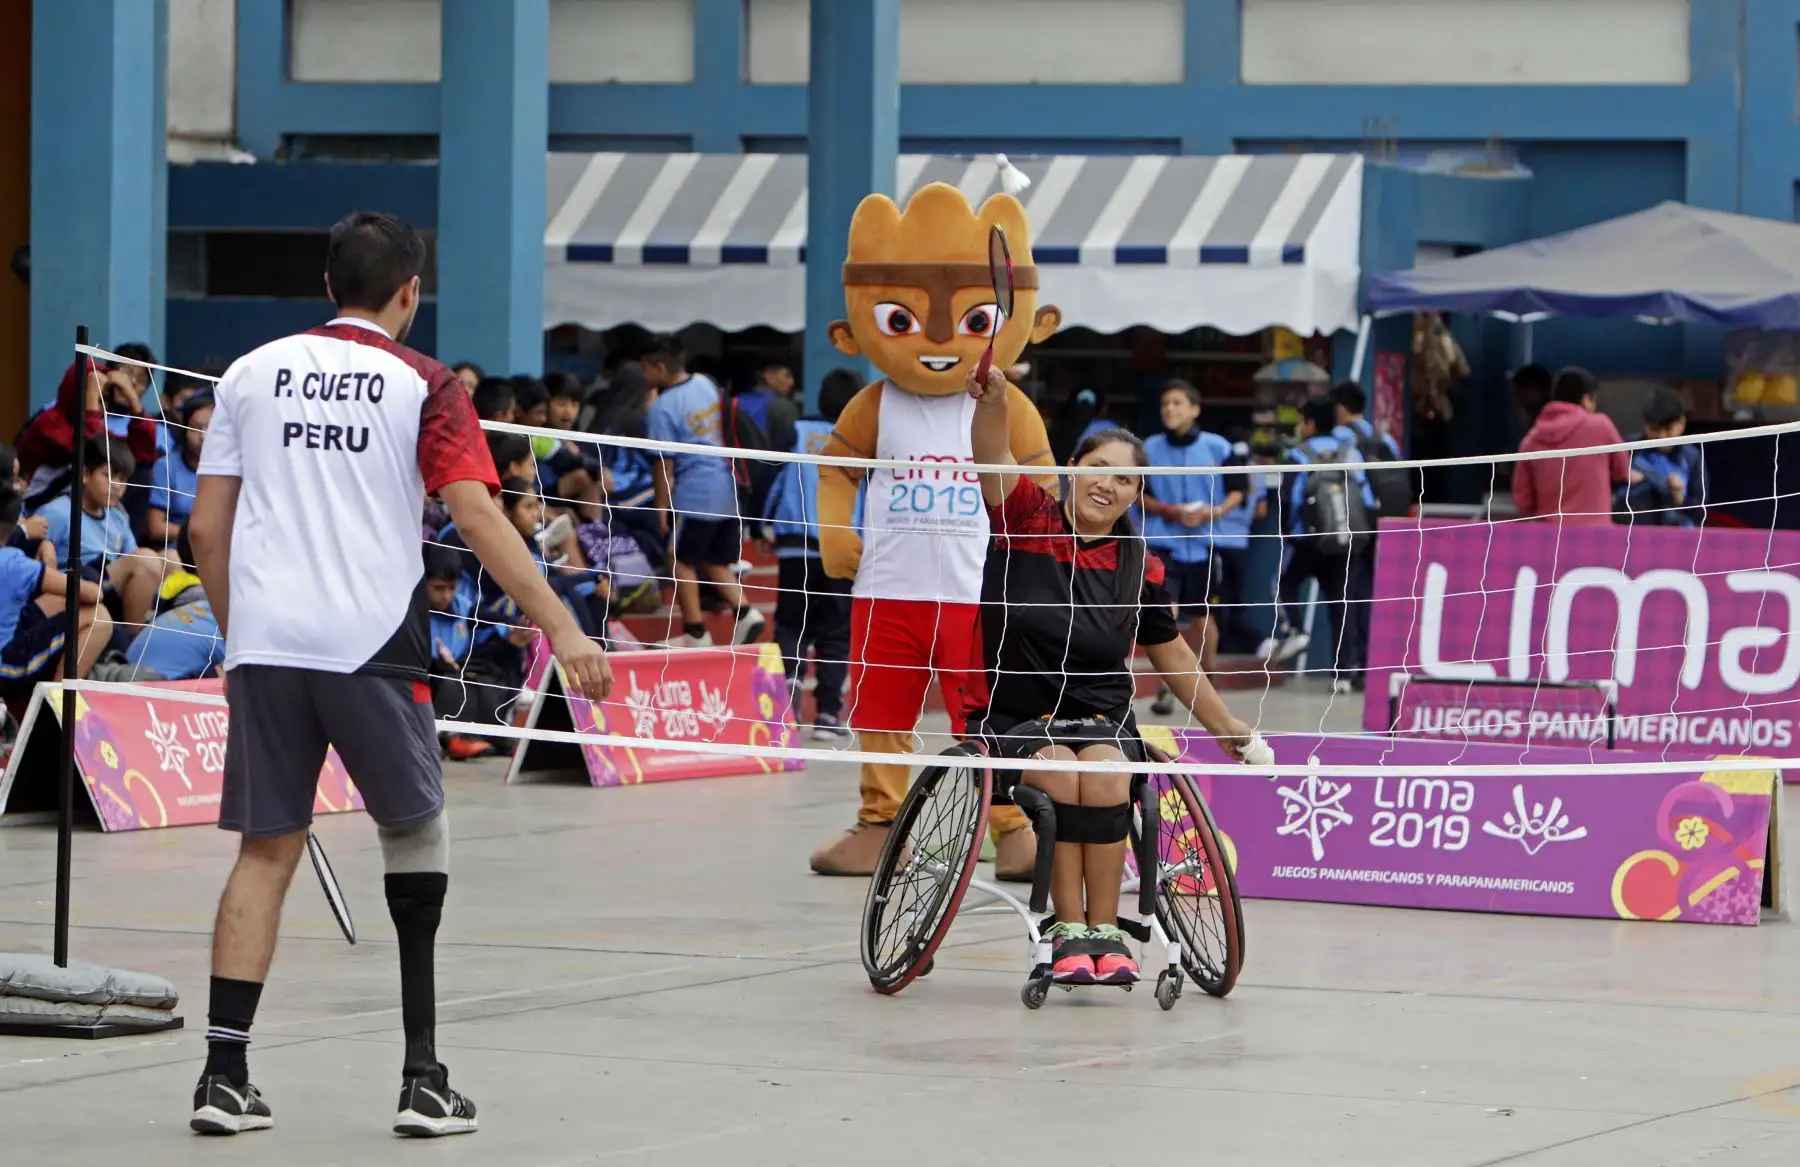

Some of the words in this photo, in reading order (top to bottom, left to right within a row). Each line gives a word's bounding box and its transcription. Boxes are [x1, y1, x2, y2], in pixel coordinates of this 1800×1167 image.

[274, 368, 293, 398] P.
[302, 371, 385, 404] CUETO
[283, 421, 370, 453] PERU
[889, 483, 980, 516] 2019
[1411, 706, 1522, 738] JUEGOS
[1530, 710, 1792, 747] PANAMERICANOS
[195, 741, 227, 773] 20
[1369, 811, 1470, 850] 2019
[1272, 865, 1317, 879] JUEGOS
[1319, 868, 1424, 885] PANAMERICANOS
[1426, 873, 1435, 886] Y
[1436, 873, 1575, 894] PARAPANAMERICANOS
